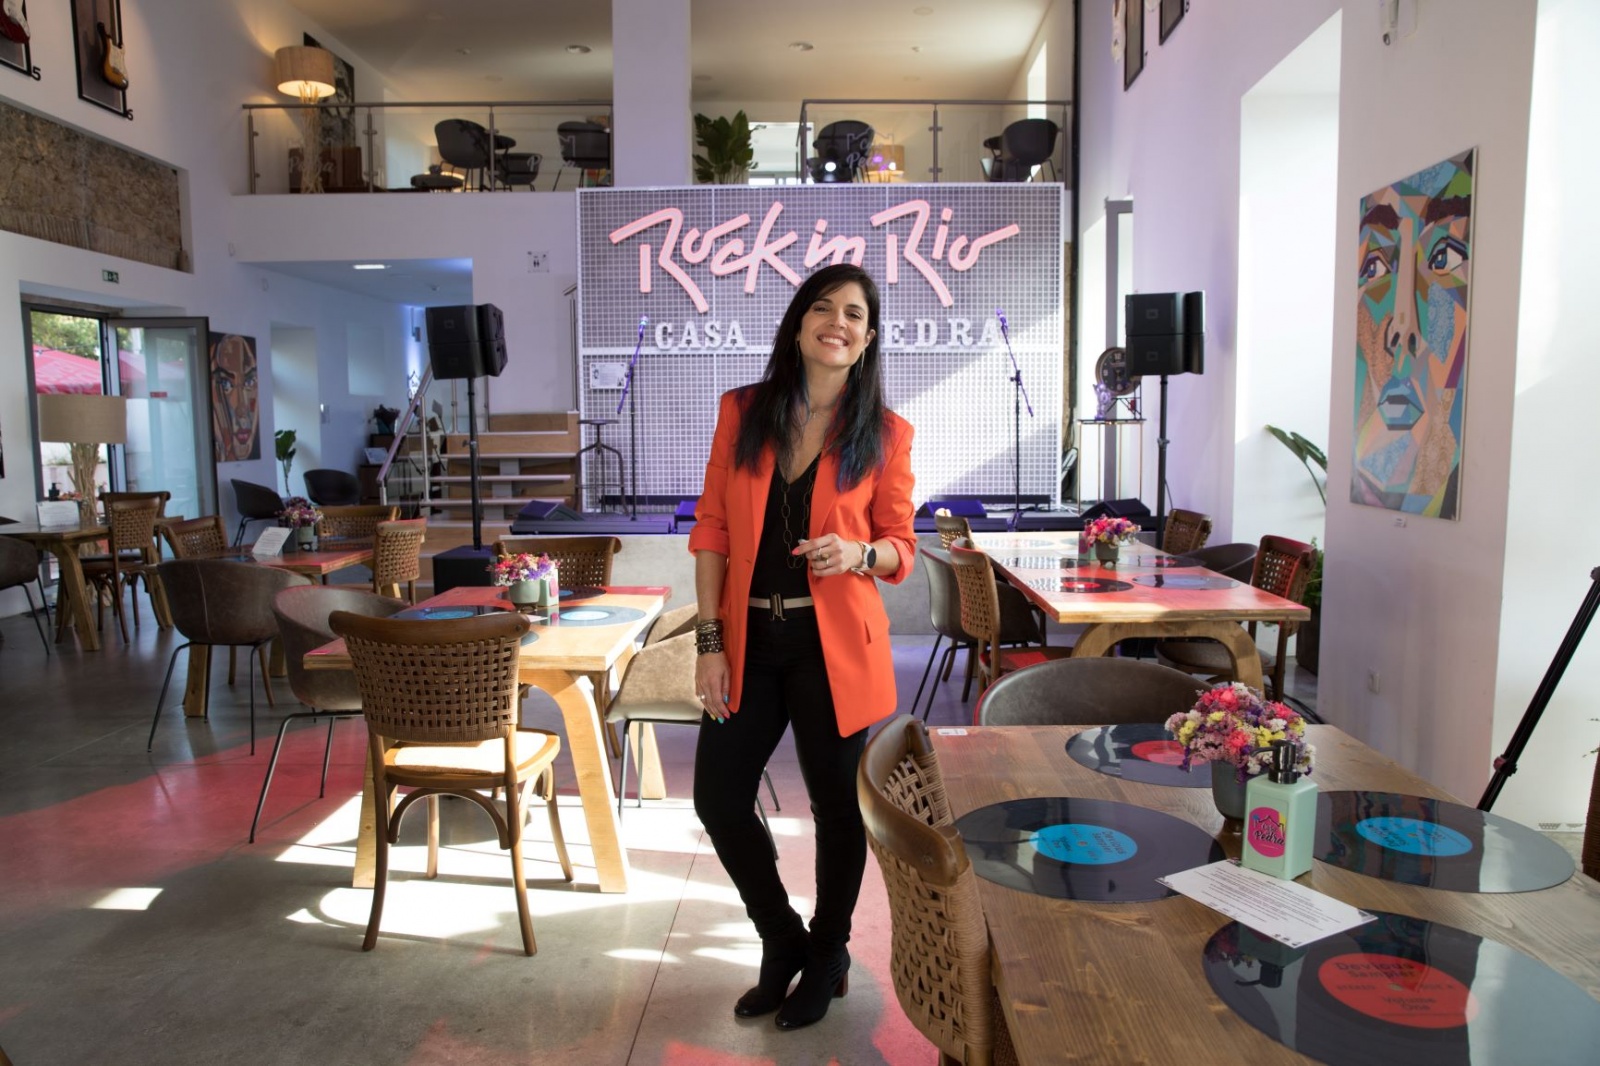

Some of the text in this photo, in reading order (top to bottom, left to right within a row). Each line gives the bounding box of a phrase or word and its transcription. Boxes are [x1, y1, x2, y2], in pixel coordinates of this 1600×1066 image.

[31, 66, 41, 81] 5
[127, 109, 134, 121] 6
[608, 199, 1020, 314] Rock in Rio
[655, 318, 1001, 351] CASA EDRA
[1254, 830, 1285, 846] Pedra
[1335, 962, 1414, 971] Devious
